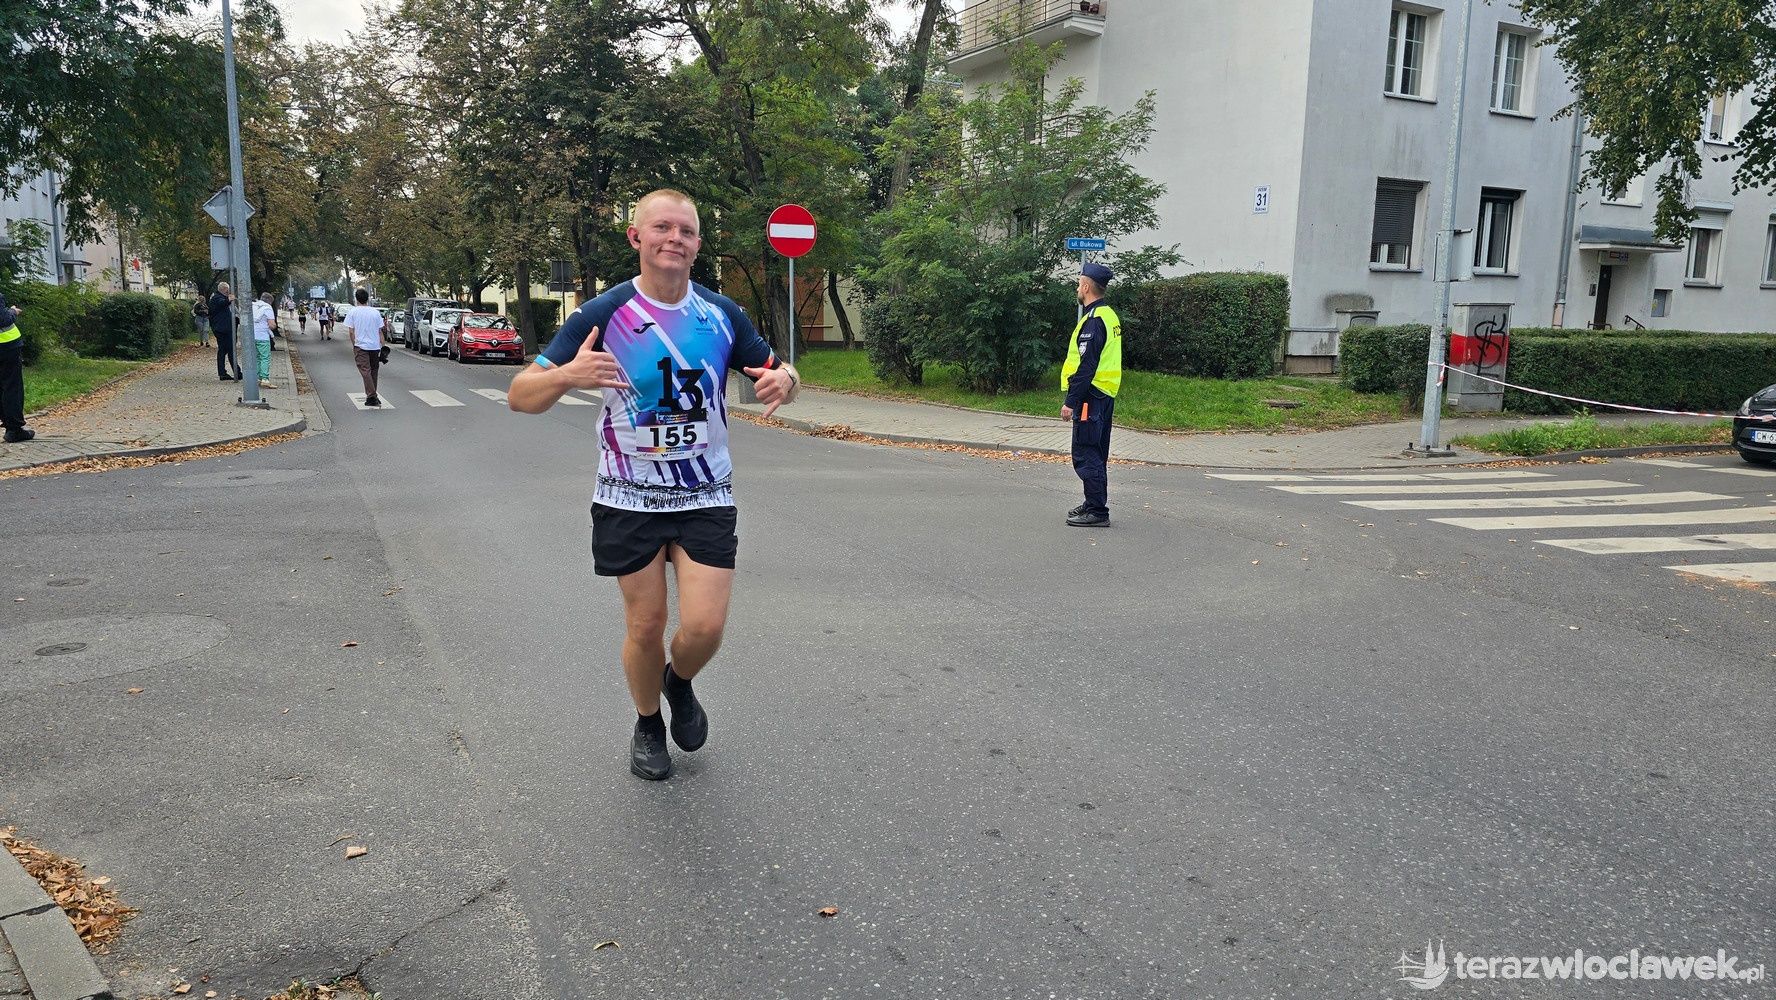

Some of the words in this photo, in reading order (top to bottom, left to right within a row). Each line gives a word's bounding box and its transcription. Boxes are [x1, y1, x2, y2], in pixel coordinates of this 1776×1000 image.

[1256, 193, 1267, 206] 31
[657, 356, 706, 412] 13
[650, 425, 697, 447] 155
